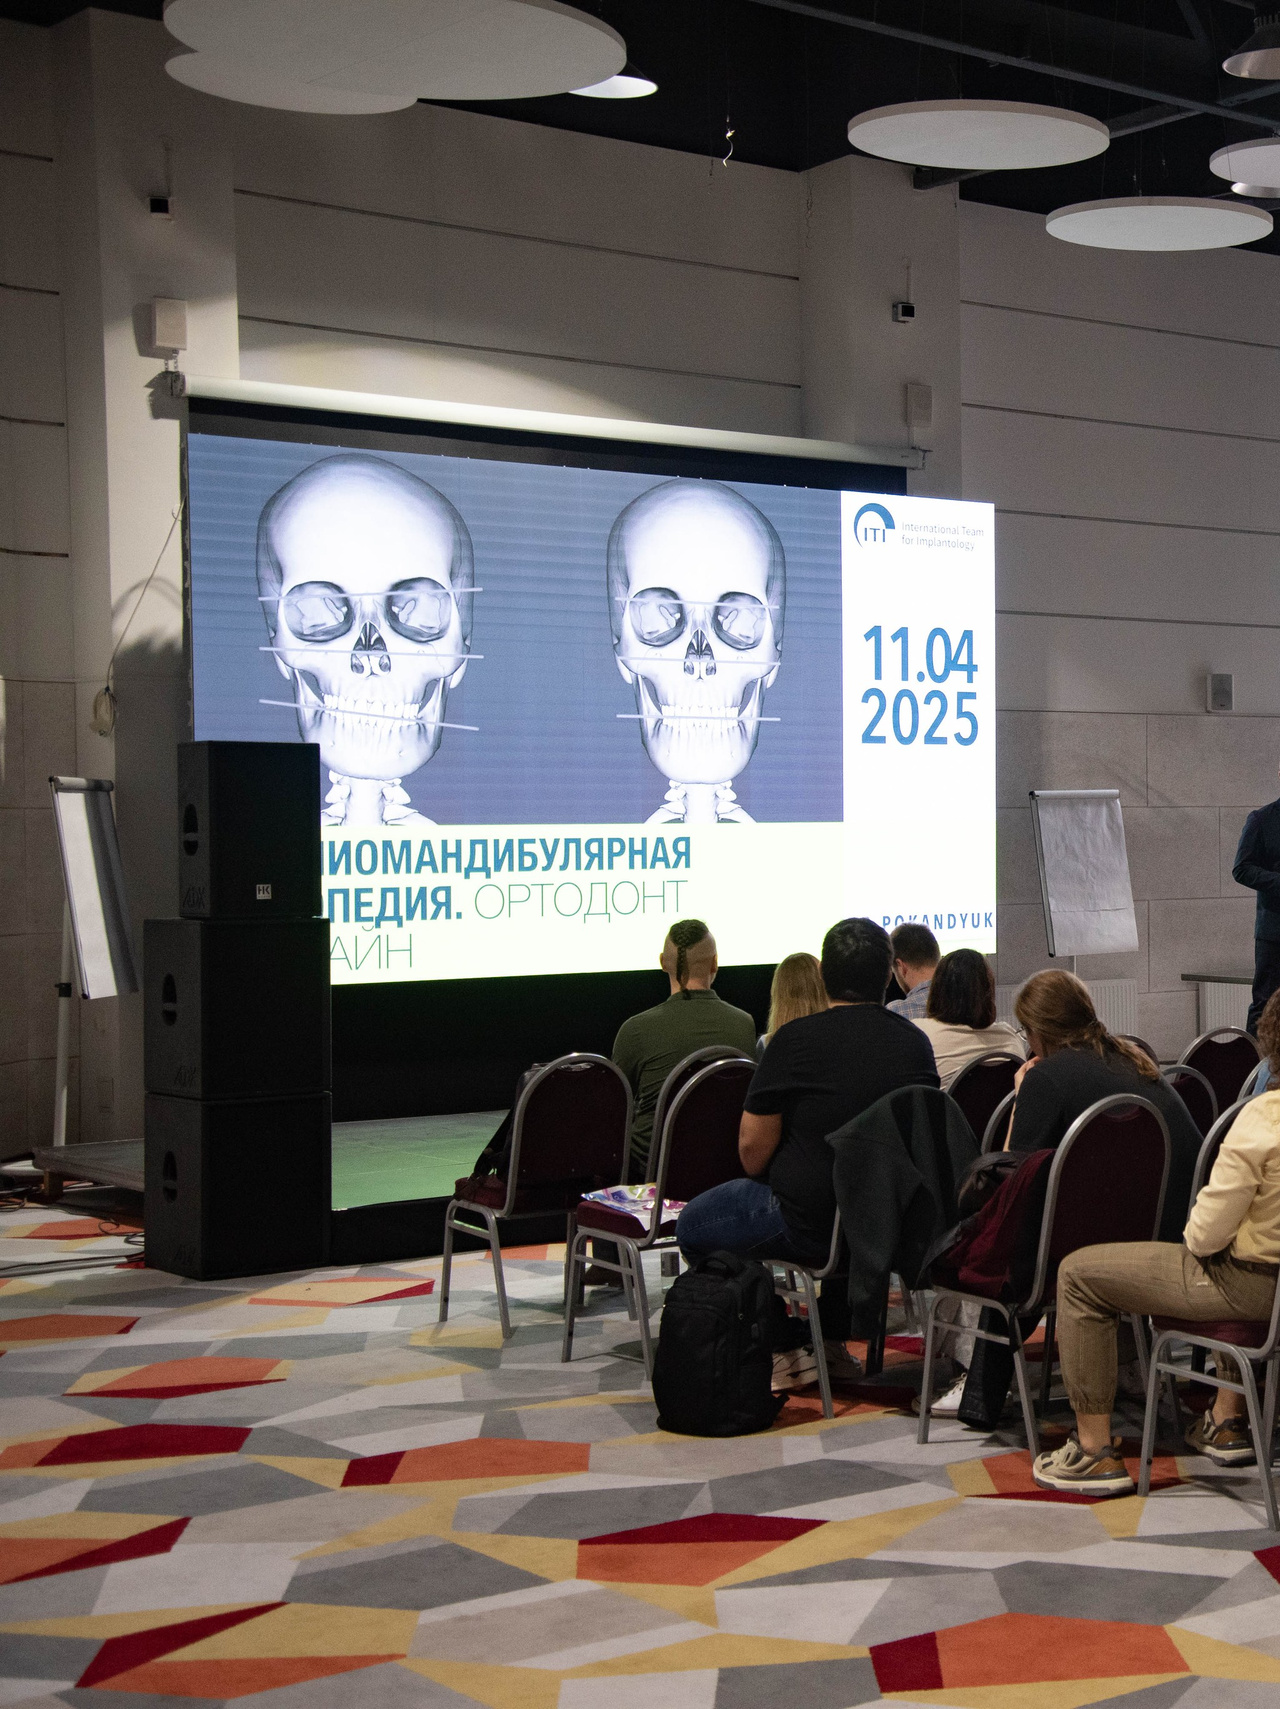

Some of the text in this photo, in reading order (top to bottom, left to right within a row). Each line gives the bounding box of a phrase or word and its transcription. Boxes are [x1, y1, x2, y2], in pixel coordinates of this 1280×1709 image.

[864, 527, 886, 542] ITI
[902, 522, 984, 537] International Team
[902, 535, 975, 552] for Implantology
[863, 625, 978, 683] 11.04
[861, 687, 979, 746] 2025
[321, 837, 690, 879] ИОМАНДИБУЛЯРНАЯ
[320, 880, 688, 928] ПЕДИЯ. ОРТОДОНТ
